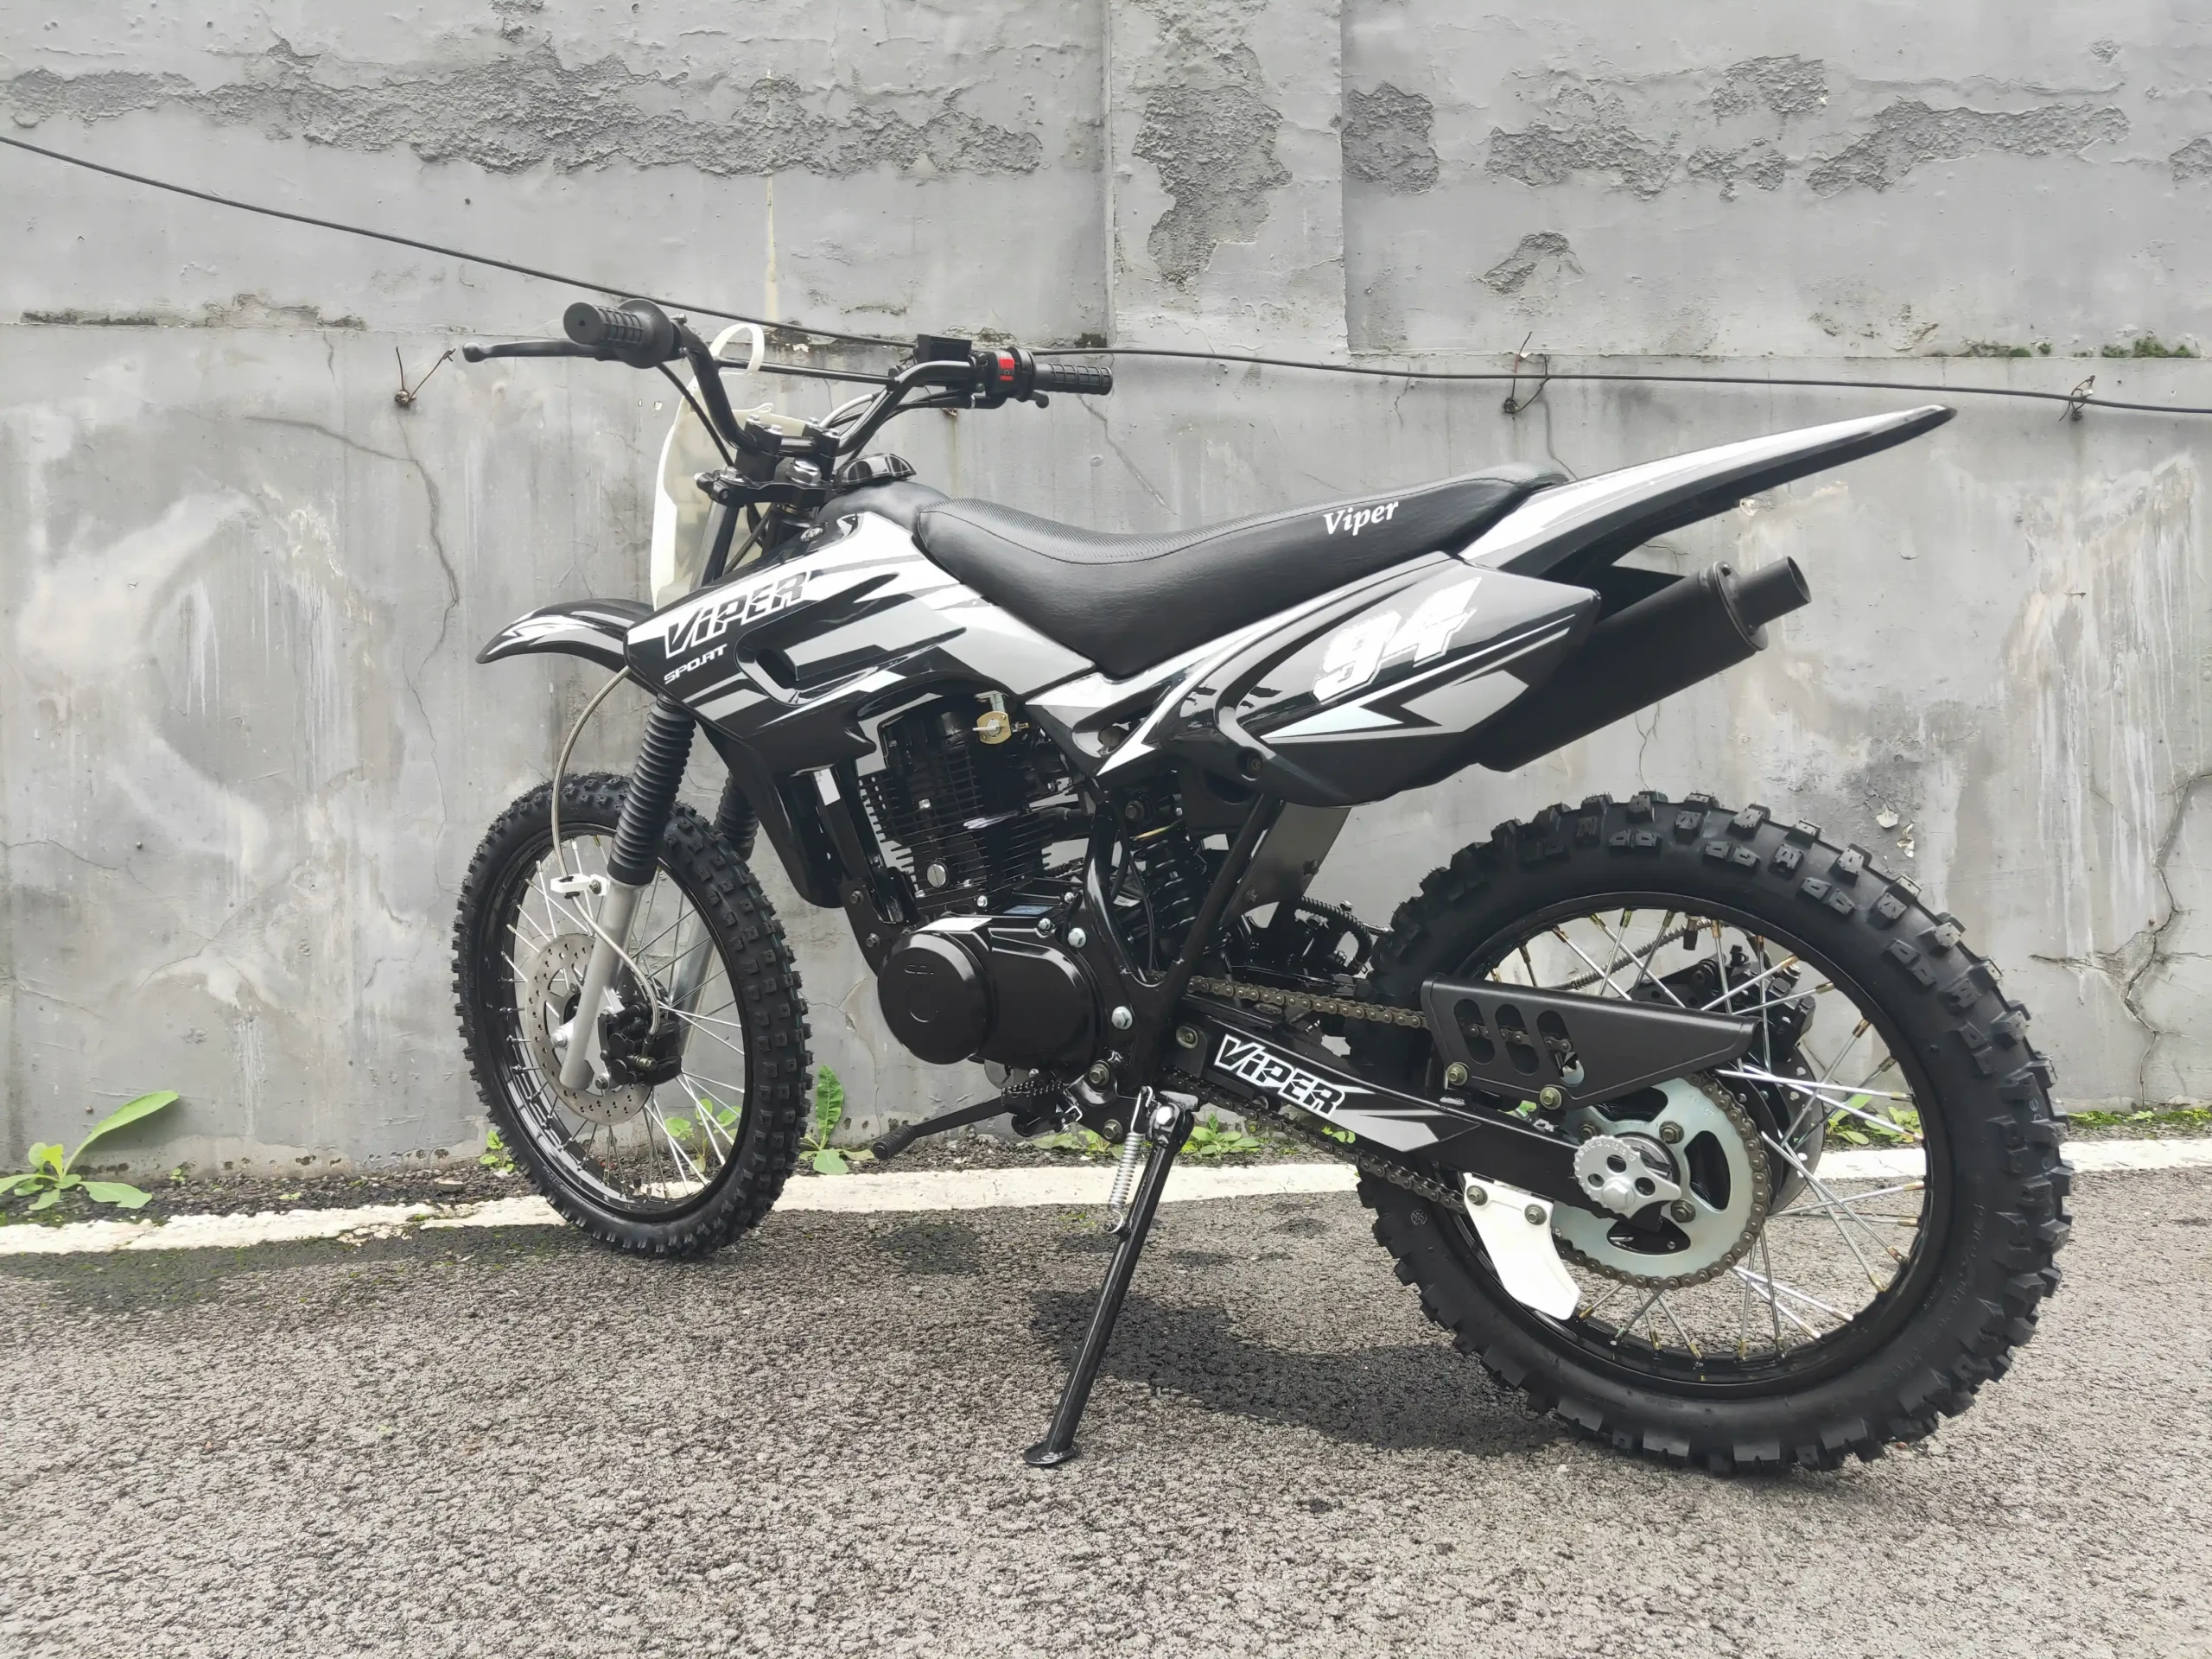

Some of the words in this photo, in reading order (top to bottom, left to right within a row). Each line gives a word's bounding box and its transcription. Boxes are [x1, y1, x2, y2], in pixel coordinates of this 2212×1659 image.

[1323, 500, 1399, 537] Viper
[1311, 575, 1483, 705] 94
[664, 643, 728, 686] SPORT
